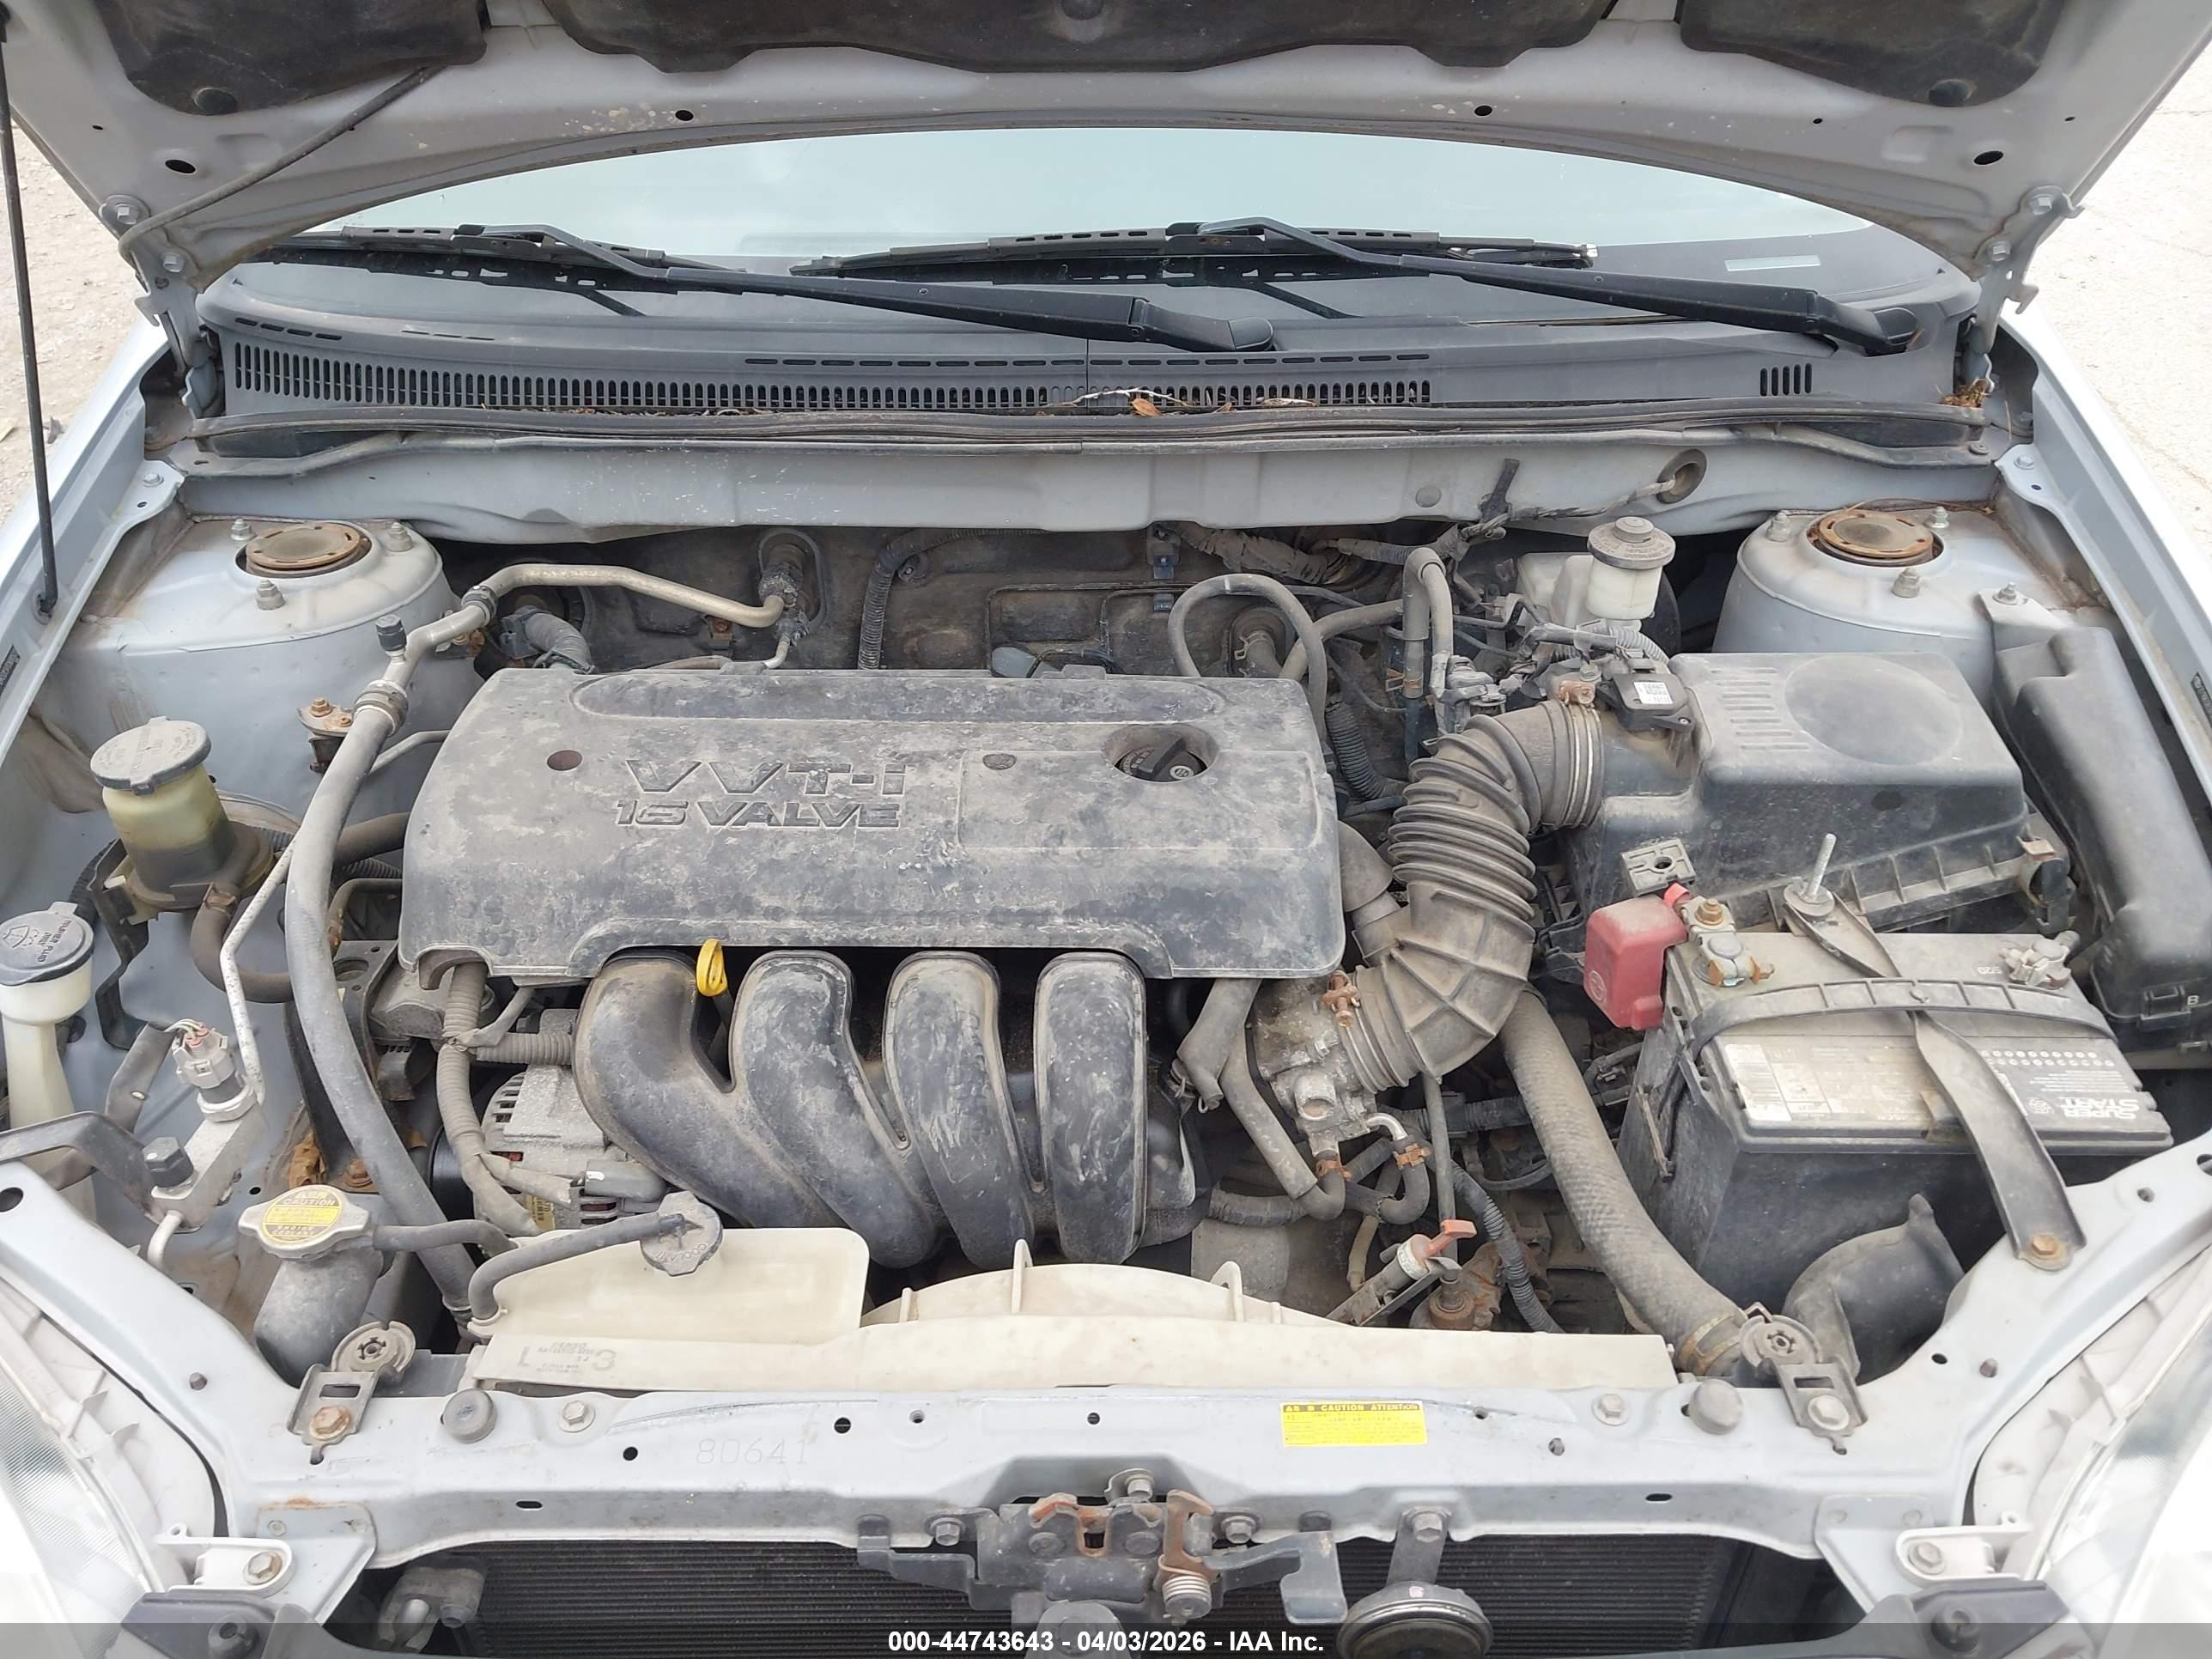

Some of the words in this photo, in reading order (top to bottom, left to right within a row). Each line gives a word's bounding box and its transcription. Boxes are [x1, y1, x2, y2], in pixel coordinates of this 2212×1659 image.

[625, 759, 907, 796] VVT-i
[616, 799, 689, 827] 16
[696, 801, 901, 828] VALVE
[2186, 995, 2199, 1006] B
[2060, 1098, 2140, 1112] START
[2063, 1108, 2136, 1120] SUPER
[696, 1437, 807, 1464] 80641
